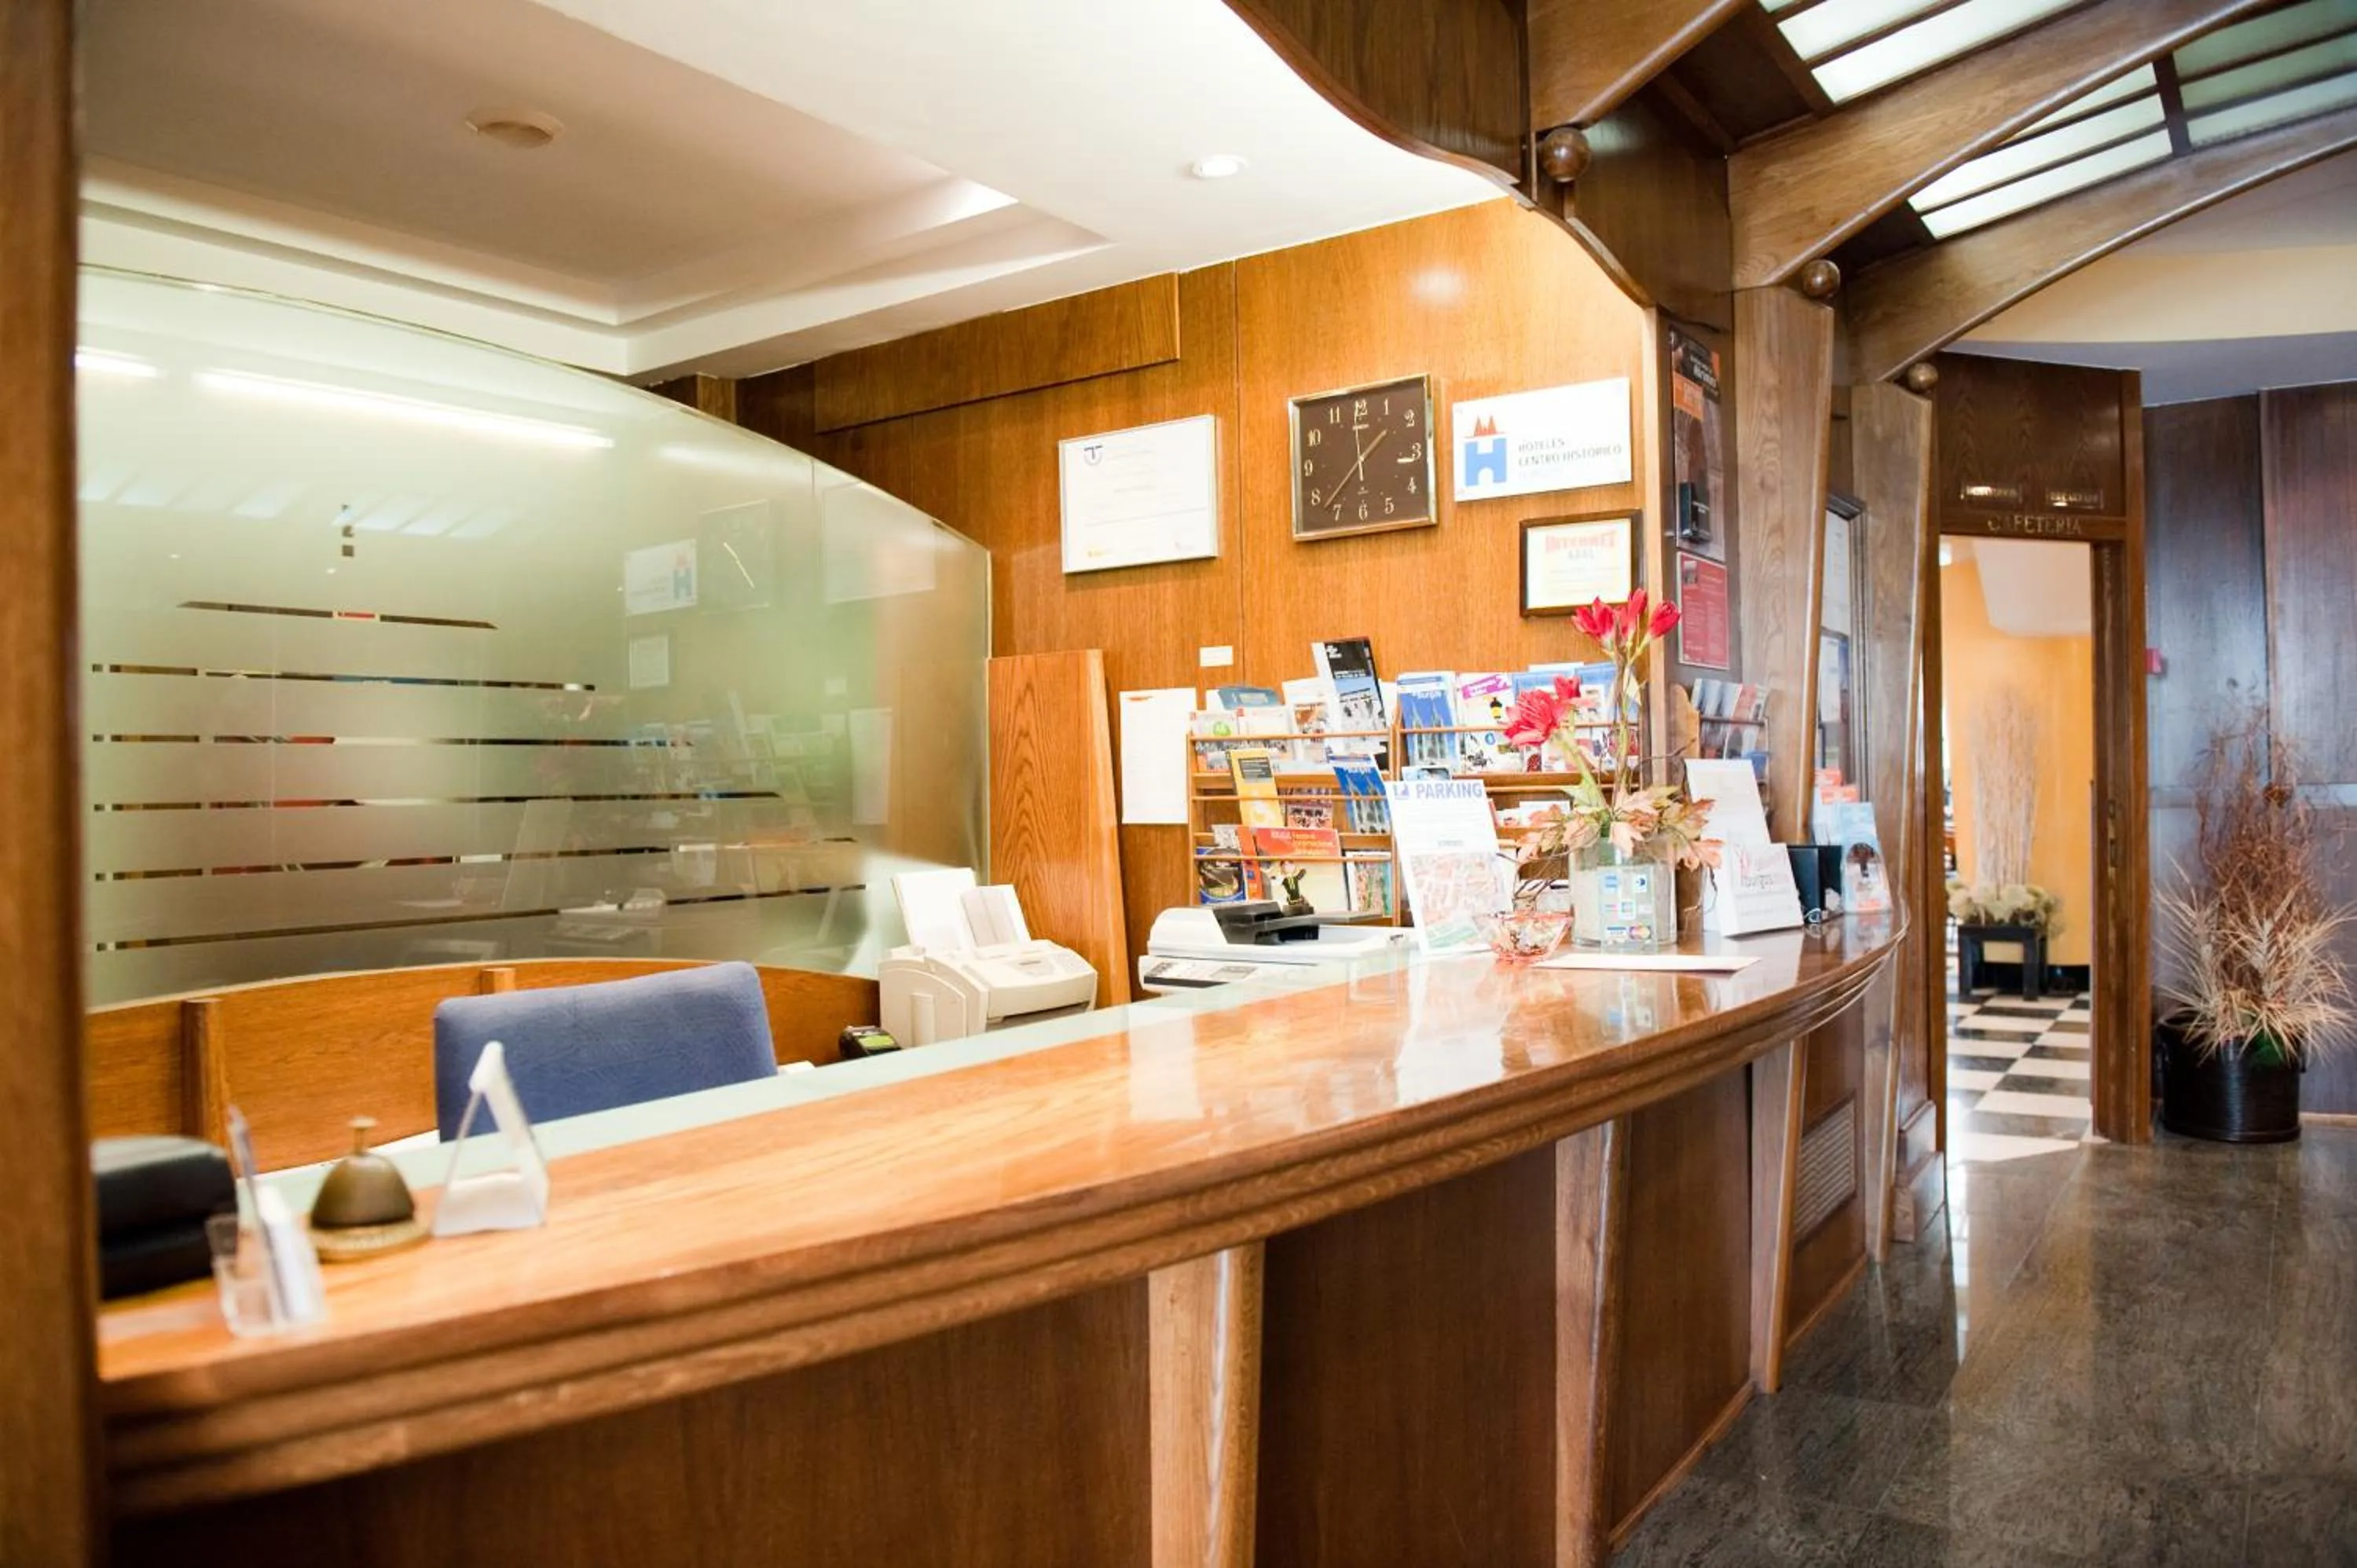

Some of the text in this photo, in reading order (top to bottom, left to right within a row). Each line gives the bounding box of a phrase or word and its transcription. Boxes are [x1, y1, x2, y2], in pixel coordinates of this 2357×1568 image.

[1329, 406, 1340, 424] 11
[1384, 399, 1390, 416] 1
[1404, 409, 1415, 427] 2
[1307, 428, 1321, 447] 10
[1518, 437, 1565, 453] HOTELES
[1412, 442, 1421, 460] 3
[1518, 452, 1560, 467] CENTRO
[1303, 459, 1314, 477] 9
[1407, 477, 1417, 494] 4
[1311, 488, 1321, 506] 8
[1384, 497, 1395, 515] 5
[1332, 504, 1342, 521] 7
[1358, 500, 1368, 520] 6
[1416, 782, 1483, 799] PARKING
